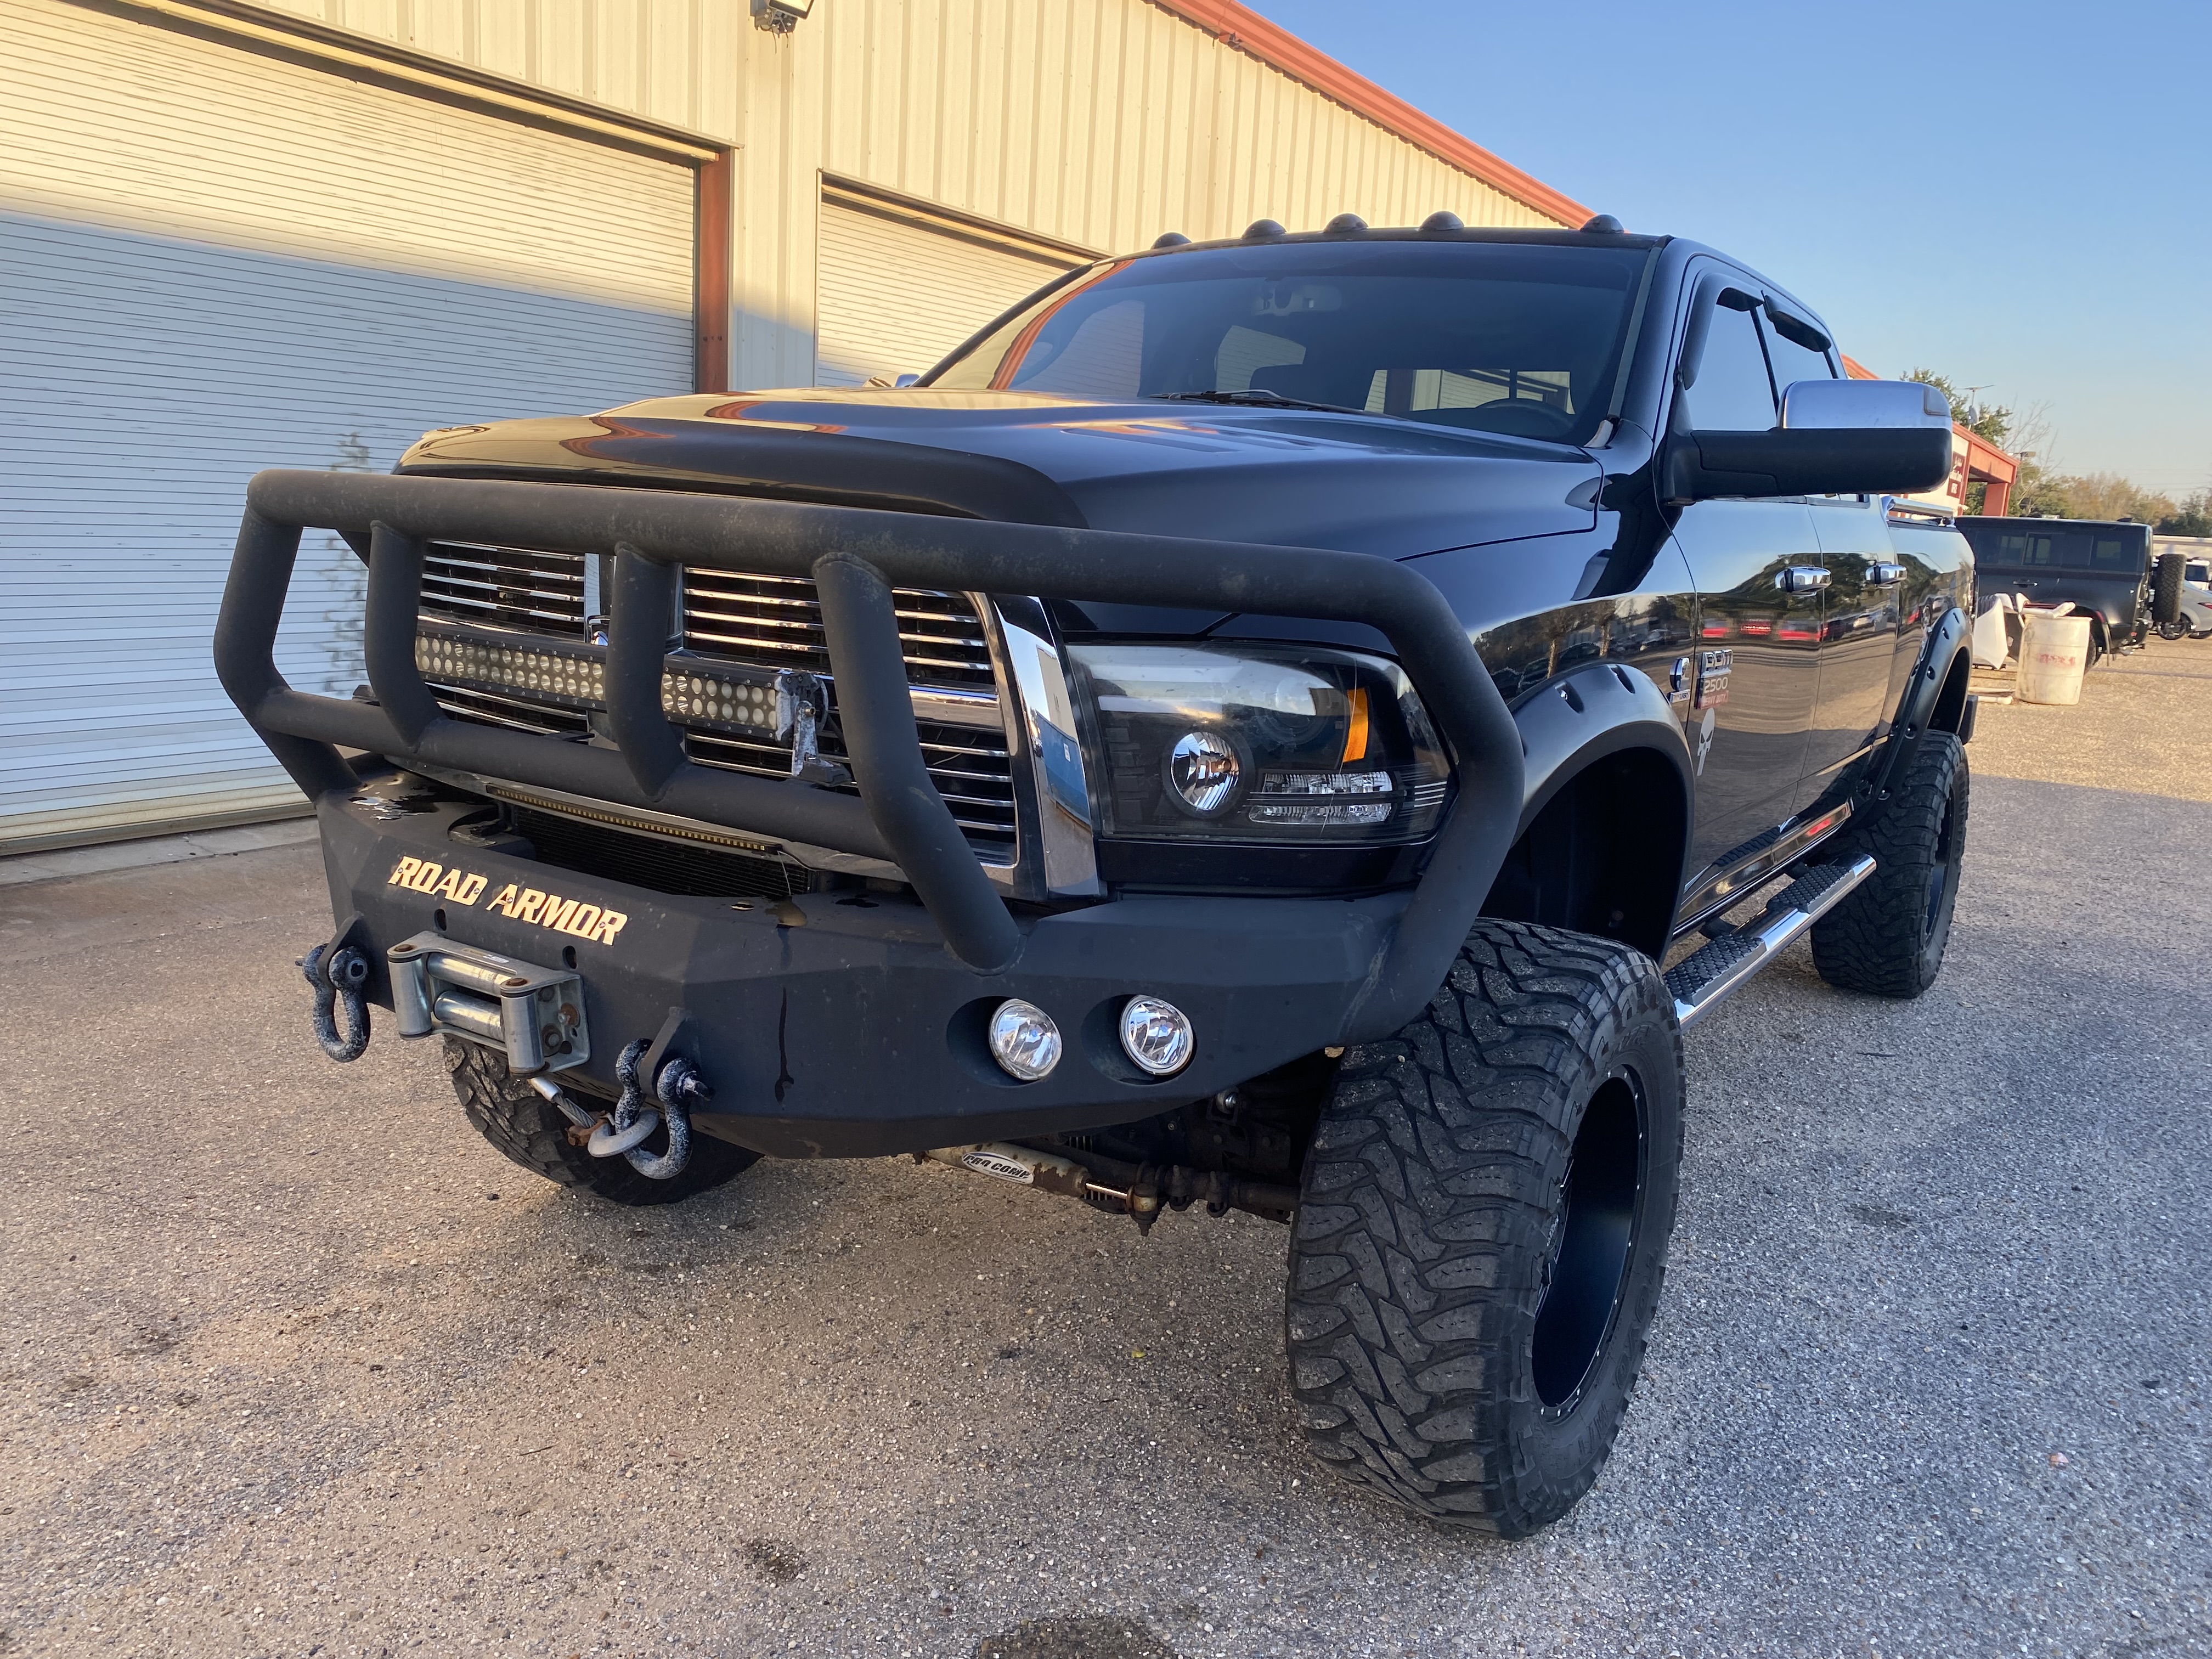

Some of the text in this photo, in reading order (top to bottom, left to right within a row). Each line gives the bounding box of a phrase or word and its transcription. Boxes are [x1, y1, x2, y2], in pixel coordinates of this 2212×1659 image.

[1704, 676, 1728, 694] 2500
[387, 856, 628, 945] ROAD ARMOR
[963, 1154, 1031, 1179] PRO COMP
